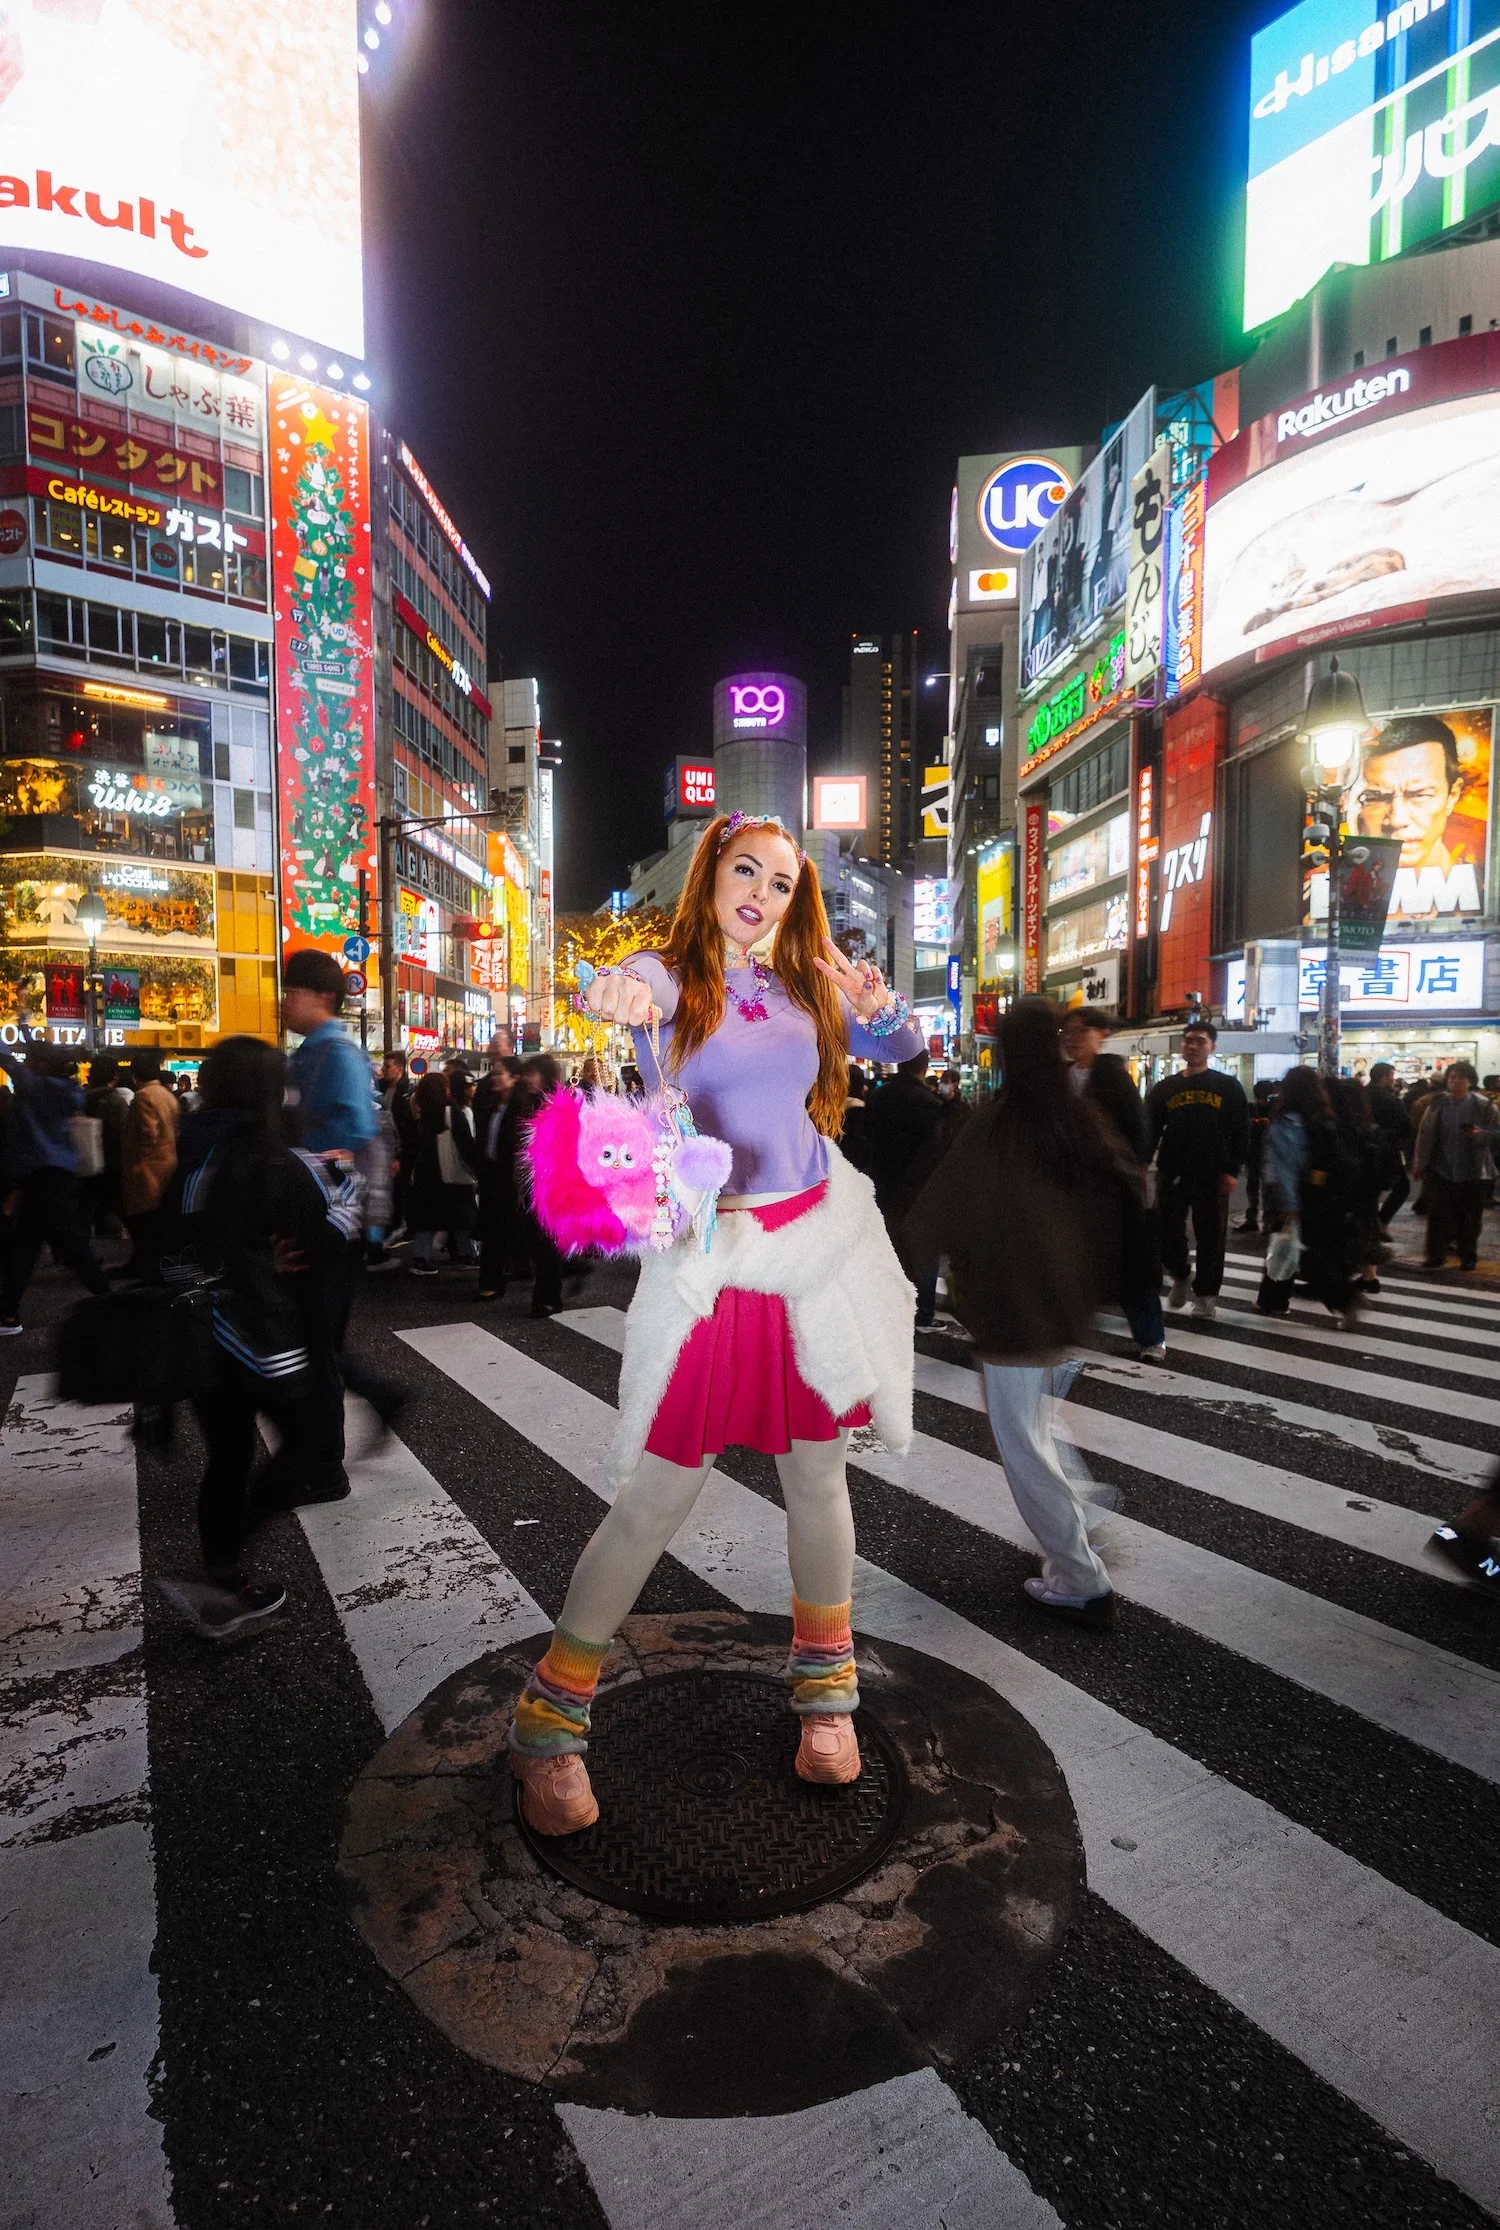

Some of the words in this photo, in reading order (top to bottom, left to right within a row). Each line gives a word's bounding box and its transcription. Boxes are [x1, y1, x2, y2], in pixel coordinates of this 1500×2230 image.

[54, 287, 254, 375] しゃぶしゃぶバイキング
[145, 364, 256, 429] しゃぶ葉
[1278, 368, 1409, 442] Rakuten
[29, 411, 219, 492] コンタクト
[989, 481, 1062, 530] UC
[165, 508, 248, 553] ガスト
[1128, 468, 1164, 665] もんじゃ
[1340, 617, 1371, 632] Vision
[730, 685, 785, 726] 109
[733, 717, 767, 728] SHIBUYA
[88, 784, 173, 816] Ushi8
[685, 771, 713, 786] UNI
[685, 787, 715, 803] QLO
[1027, 827, 1039, 947] ウィンターフルーツギフト
